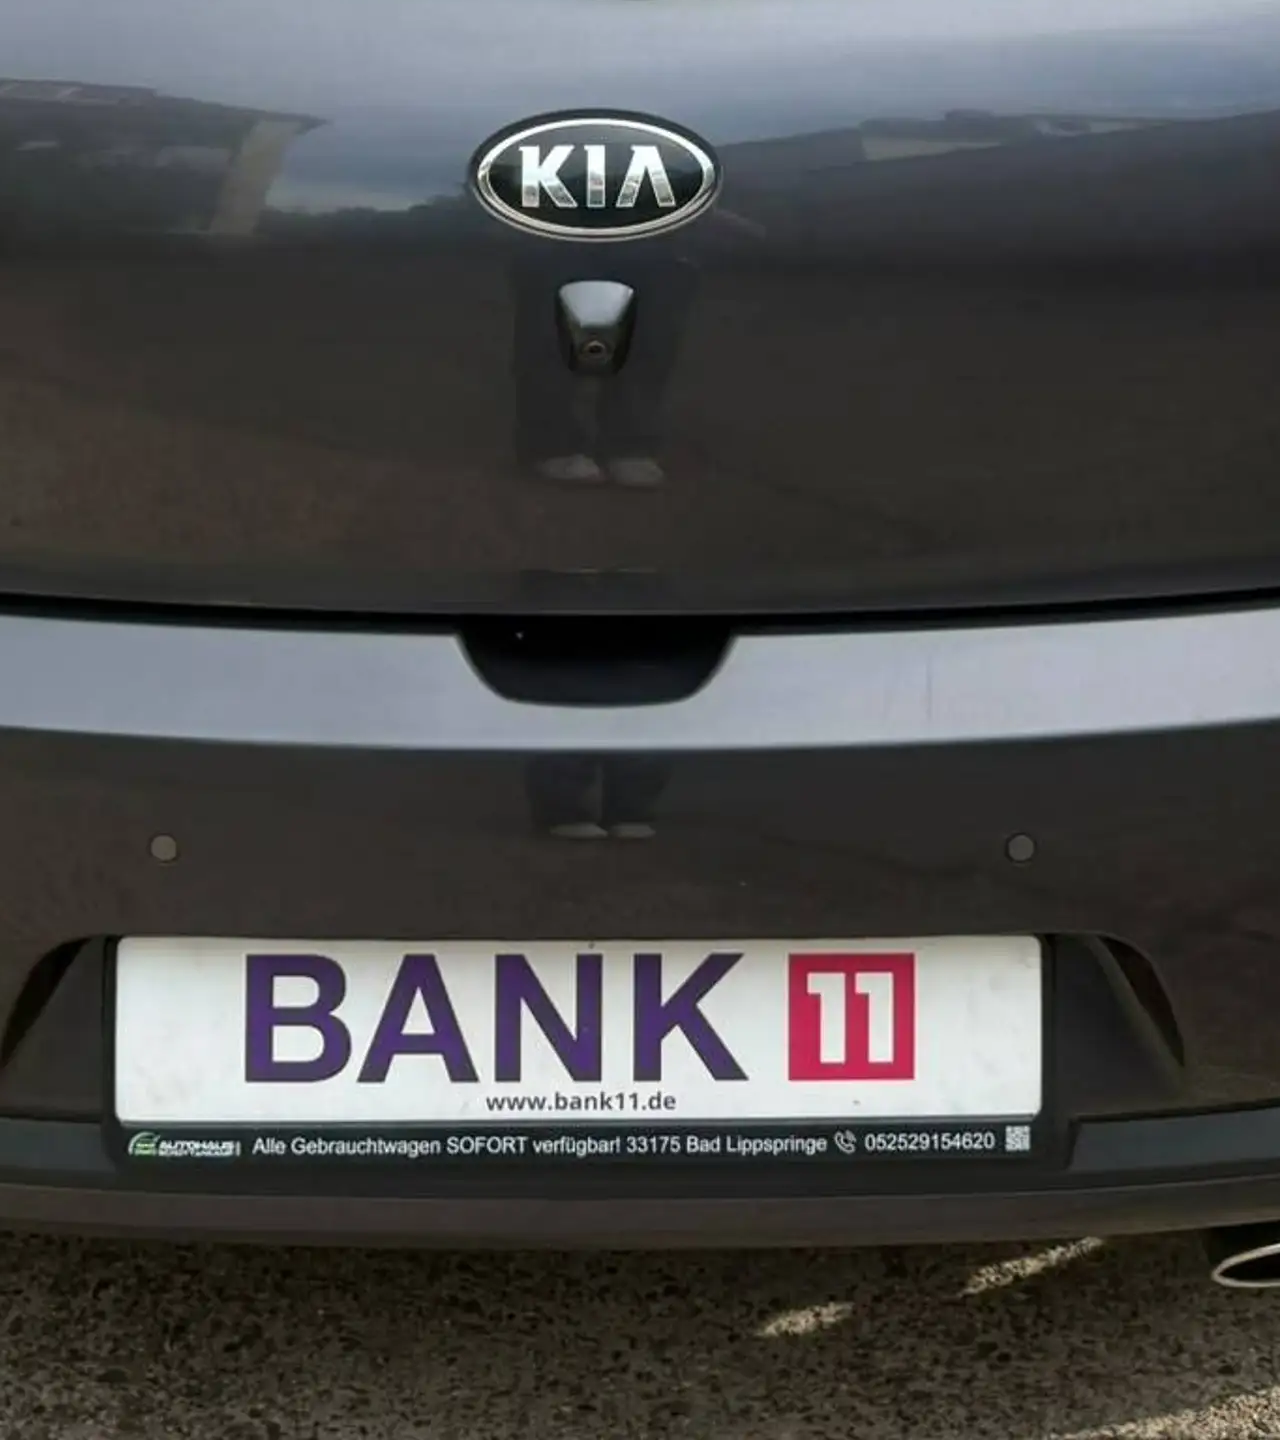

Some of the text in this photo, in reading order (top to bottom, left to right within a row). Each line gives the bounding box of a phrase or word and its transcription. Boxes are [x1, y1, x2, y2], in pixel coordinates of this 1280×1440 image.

[518, 144, 677, 209] KIA
[244, 952, 895, 1085] BANK 11
[485, 1090, 677, 1112] www.bank11.de
[251, 1136, 287, 1155] Alle
[290, 1136, 442, 1159] Gebrauchtwagen
[446, 1135, 529, 1154] SOFORT
[532, 1135, 621, 1159] verfügbar!
[626, 1135, 681, 1154] 33175
[686, 1135, 721, 1154] Bad
[725, 1134, 828, 1157] Lippspringe
[864, 1131, 996, 1152] 052529154620
